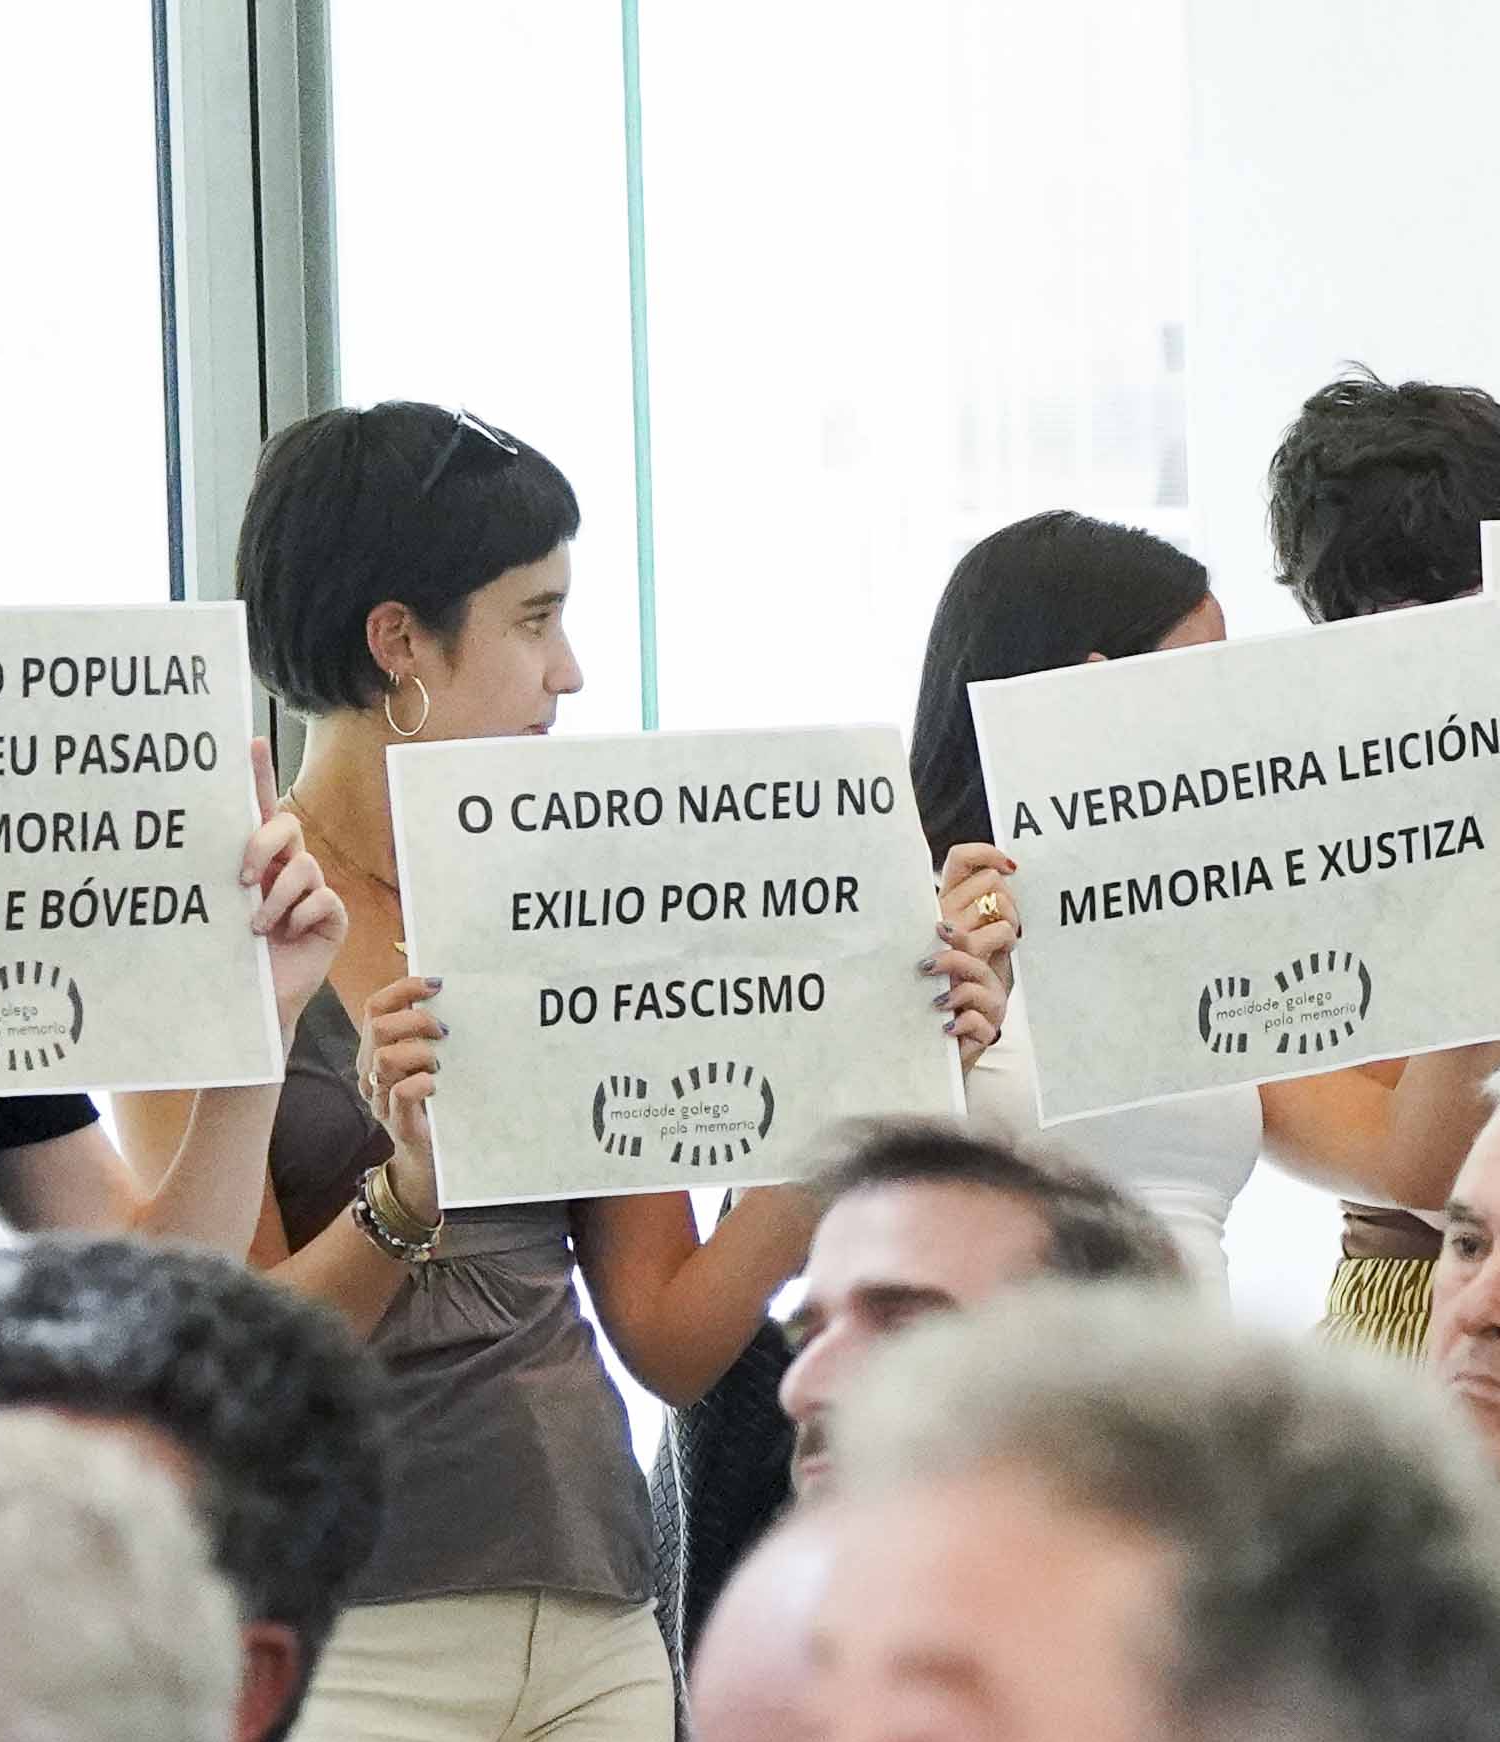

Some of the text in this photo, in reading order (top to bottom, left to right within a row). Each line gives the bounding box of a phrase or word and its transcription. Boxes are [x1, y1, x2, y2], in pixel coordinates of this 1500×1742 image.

[23, 656, 209, 698] POPULAR
[55, 731, 216, 775] PASADO
[458, 777, 894, 833] O CADRO NACEU NO
[1013, 802, 1043, 839] A
[1050, 751, 1327, 830] VERDADEIRA
[135, 809, 185, 850] DE
[1060, 816, 1484, 926] MEMORIA E XUSTIZA
[6, 891, 26, 931] E
[41, 877, 209, 929] BÓVEDA
[512, 876, 859, 931] EXILIO POR MOR
[540, 973, 824, 1027] DO FASCISMO
